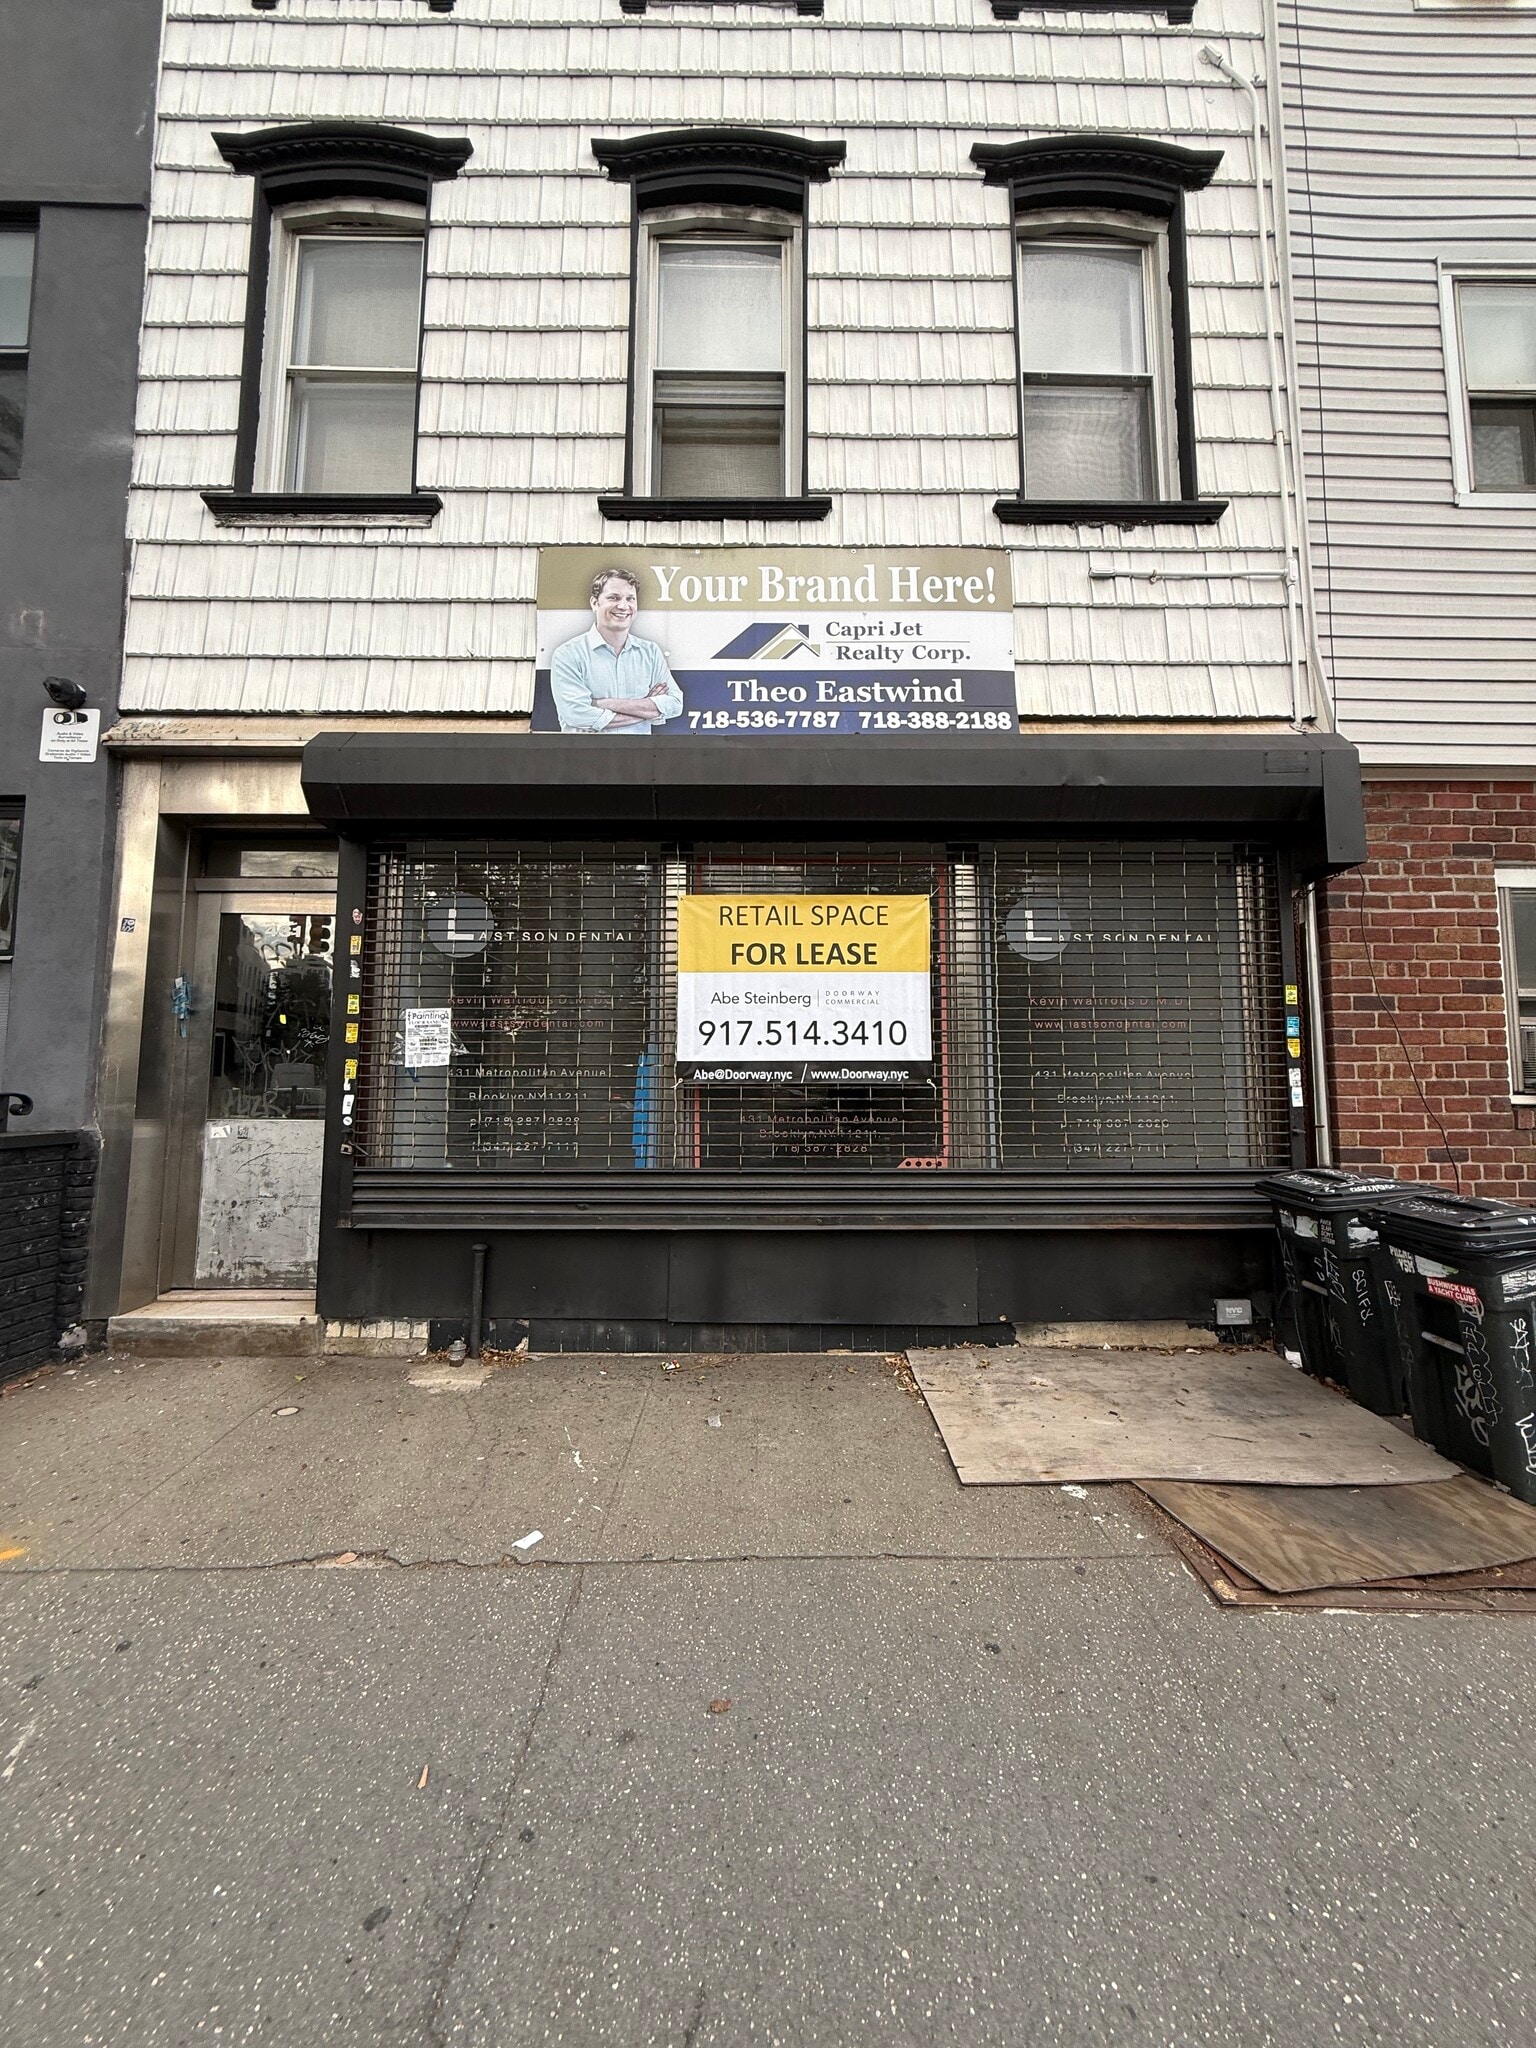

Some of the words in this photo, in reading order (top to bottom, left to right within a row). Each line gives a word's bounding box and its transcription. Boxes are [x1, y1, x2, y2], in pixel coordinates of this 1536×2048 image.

[650, 566, 749, 602] Your
[758, 564, 879, 602] Brand
[888, 566, 996, 604] Here!
[826, 621, 884, 640] Capri
[890, 622, 923, 636] Jet
[836, 645, 904, 663] Realty
[912, 645, 970, 664] Corp.
[727, 679, 807, 702] Theo
[815, 678, 965, 703] Eastwind
[688, 711, 840, 729] 718-536-7787
[858, 711, 1012, 730] 718-388-2188
[720, 905, 803, 926] RETAIL
[810, 904, 889, 926] SPACE
[522, 932, 558, 941] SON
[731, 943, 787, 965] FOR
[796, 943, 878, 965] LEASE
[711, 991, 740, 1004] Abe
[745, 991, 811, 1007] Steinberg
[698, 1020, 907, 1046] 917.514.3410
[693, 1069, 793, 1081] Abe@Doorway.nyc
[811, 1068, 909, 1082] www.Doorway.nyc
[1427, 1277, 1460, 1292] BUSHWICK
[1460, 1283, 1476, 1296] HAS
[1433, 1287, 1454, 1299] YACHT
